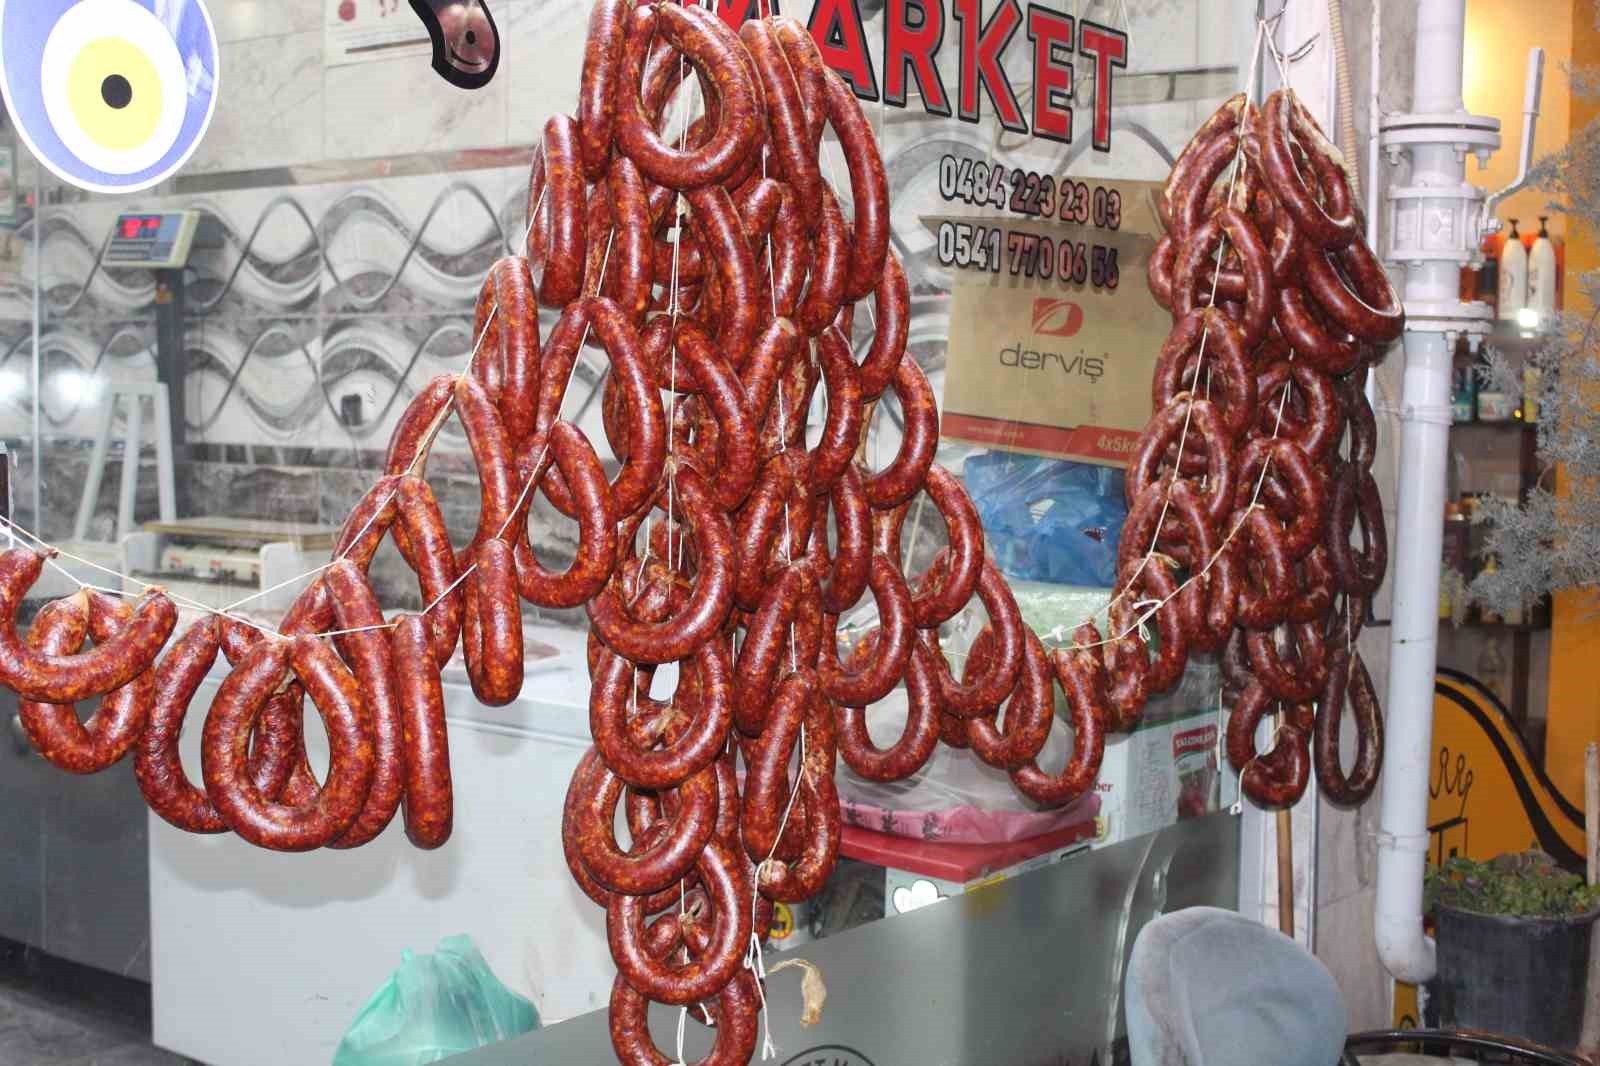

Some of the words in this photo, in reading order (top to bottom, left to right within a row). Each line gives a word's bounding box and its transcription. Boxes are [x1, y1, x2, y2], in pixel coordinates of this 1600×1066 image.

[939, 154, 1006, 209] 0484
[1010, 168, 1056, 217] 223
[1059, 179, 1089, 224] 23
[1093, 186, 1121, 230] 03
[938, 220, 1001, 273] 0541
[1008, 230, 1054, 279] 770
[1058, 239, 1087, 284] 06
[999, 341, 1104, 384] derviş
